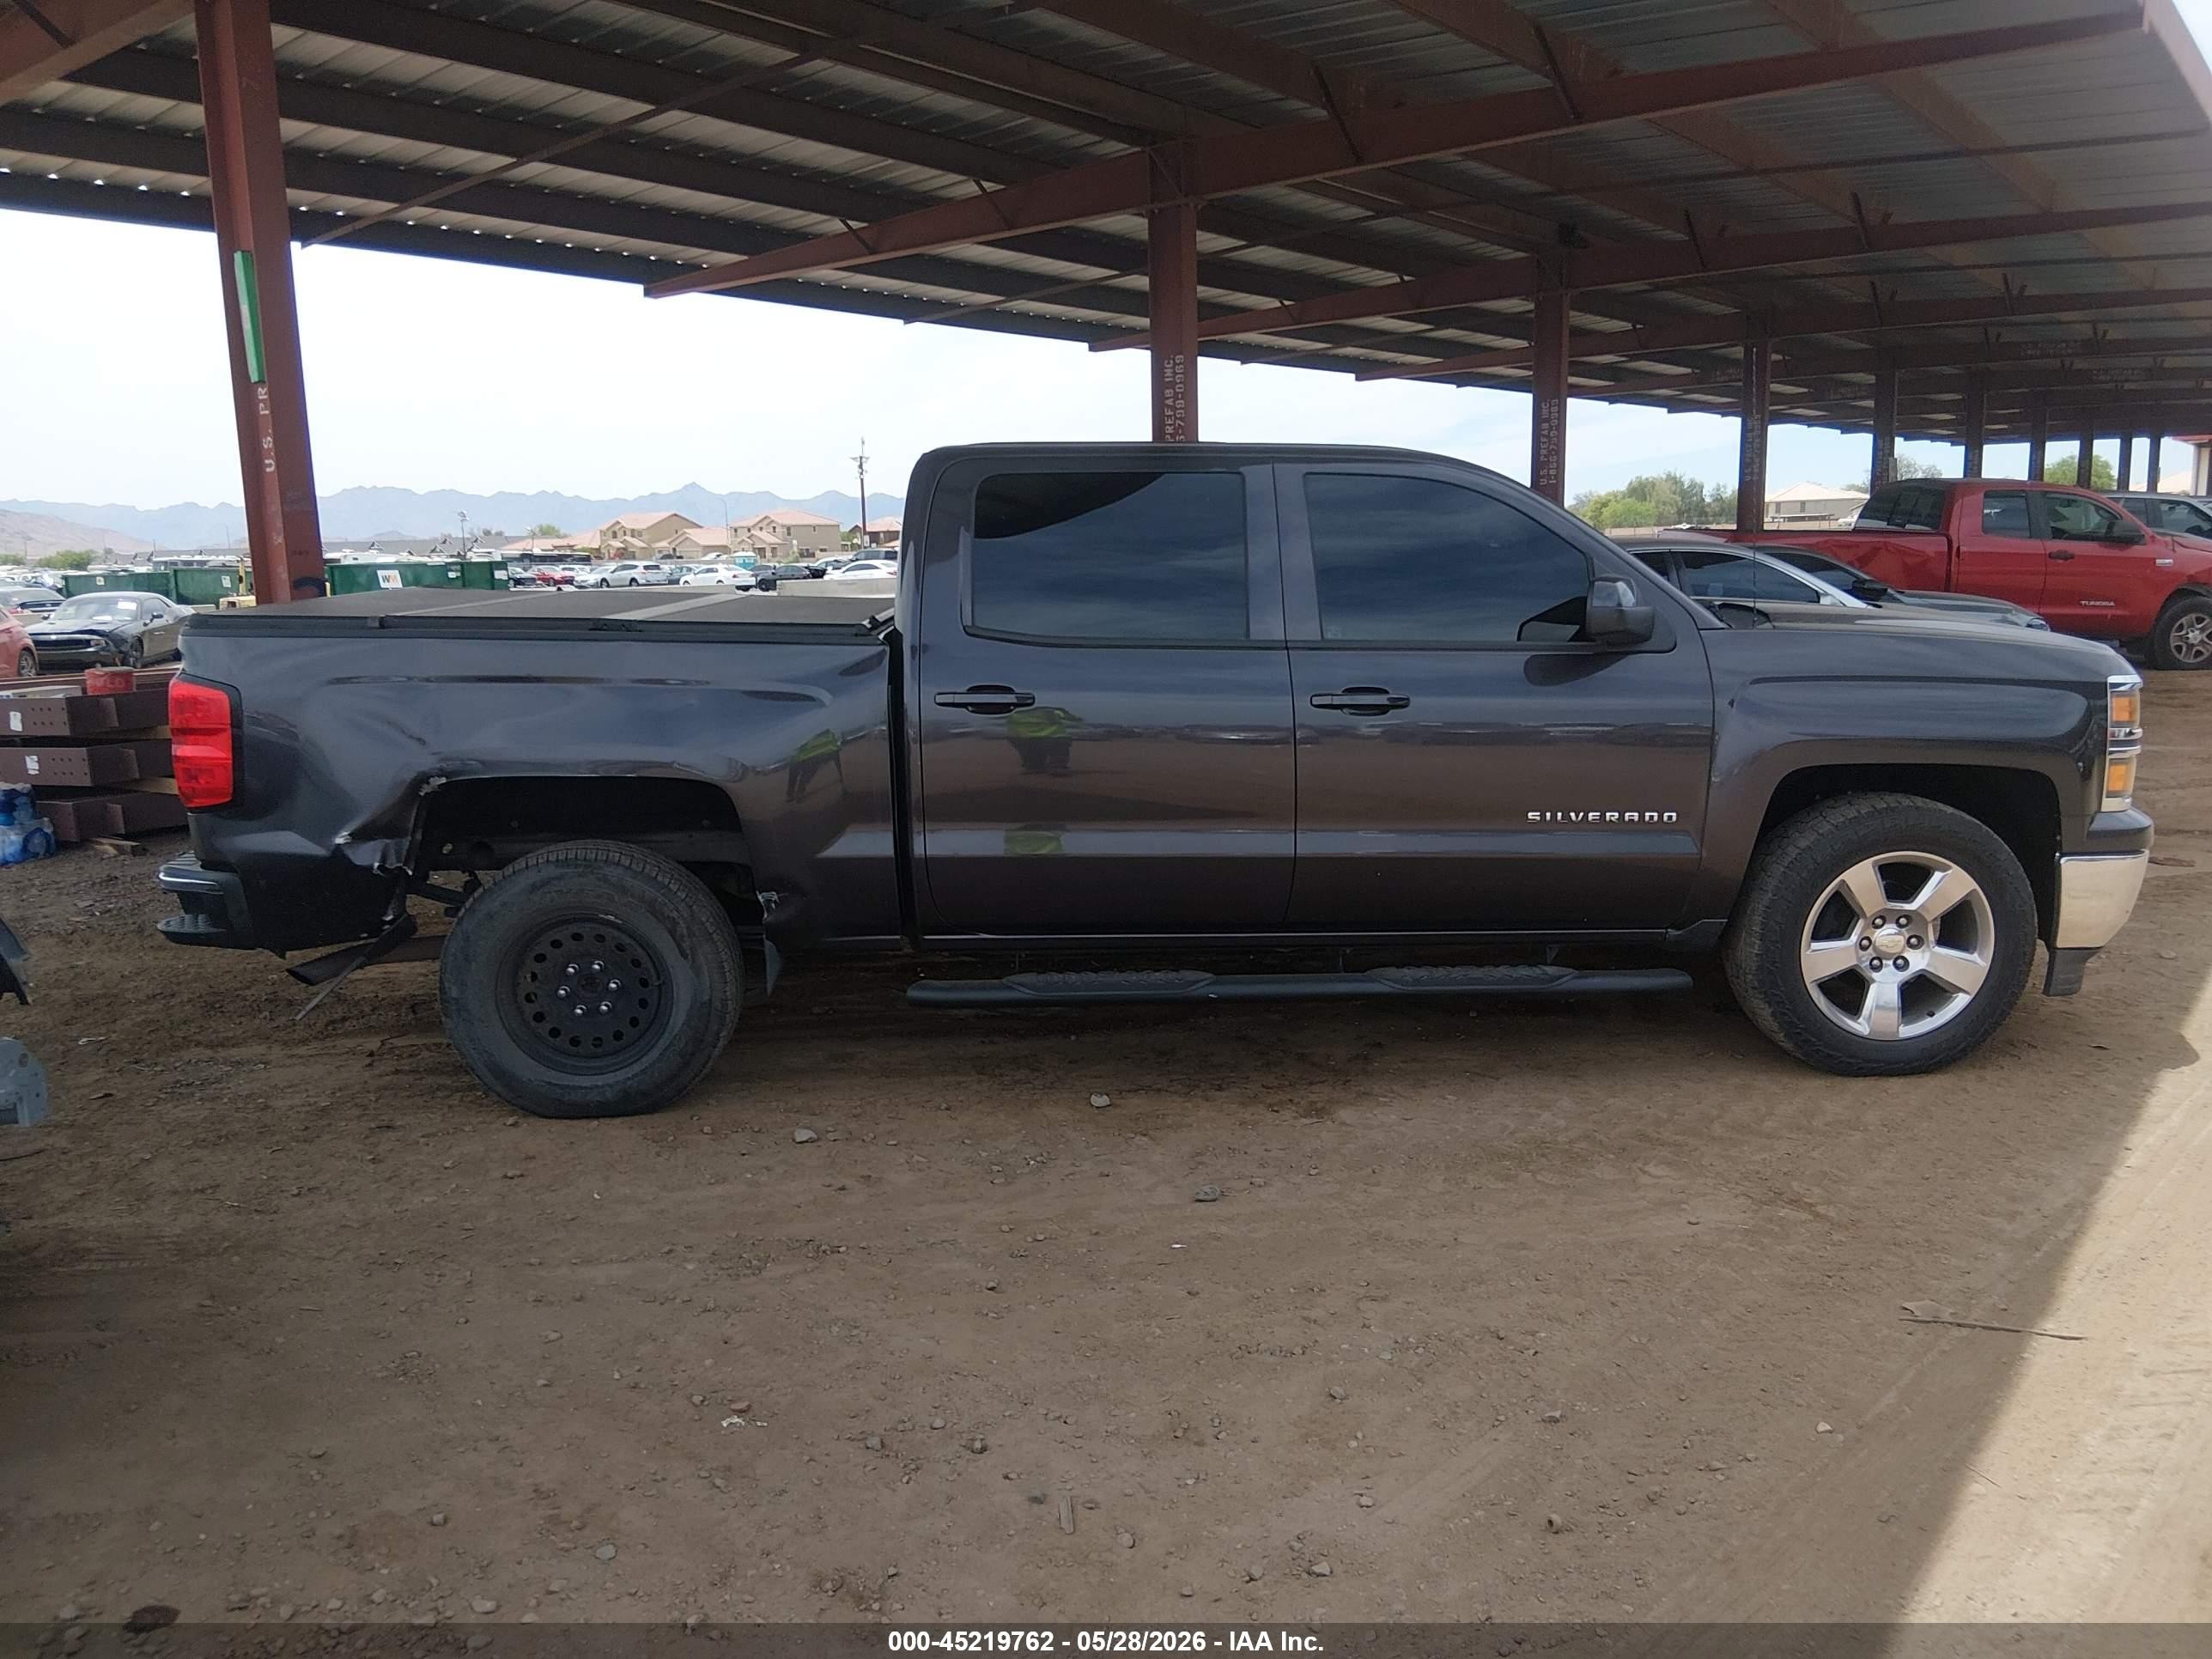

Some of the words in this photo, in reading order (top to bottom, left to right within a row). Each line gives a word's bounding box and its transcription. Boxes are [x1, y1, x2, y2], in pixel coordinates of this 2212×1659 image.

[1164, 355, 1175, 382] INC.
[262, 429, 276, 472] U.S.
[1527, 811, 1678, 823] SILVERADO
